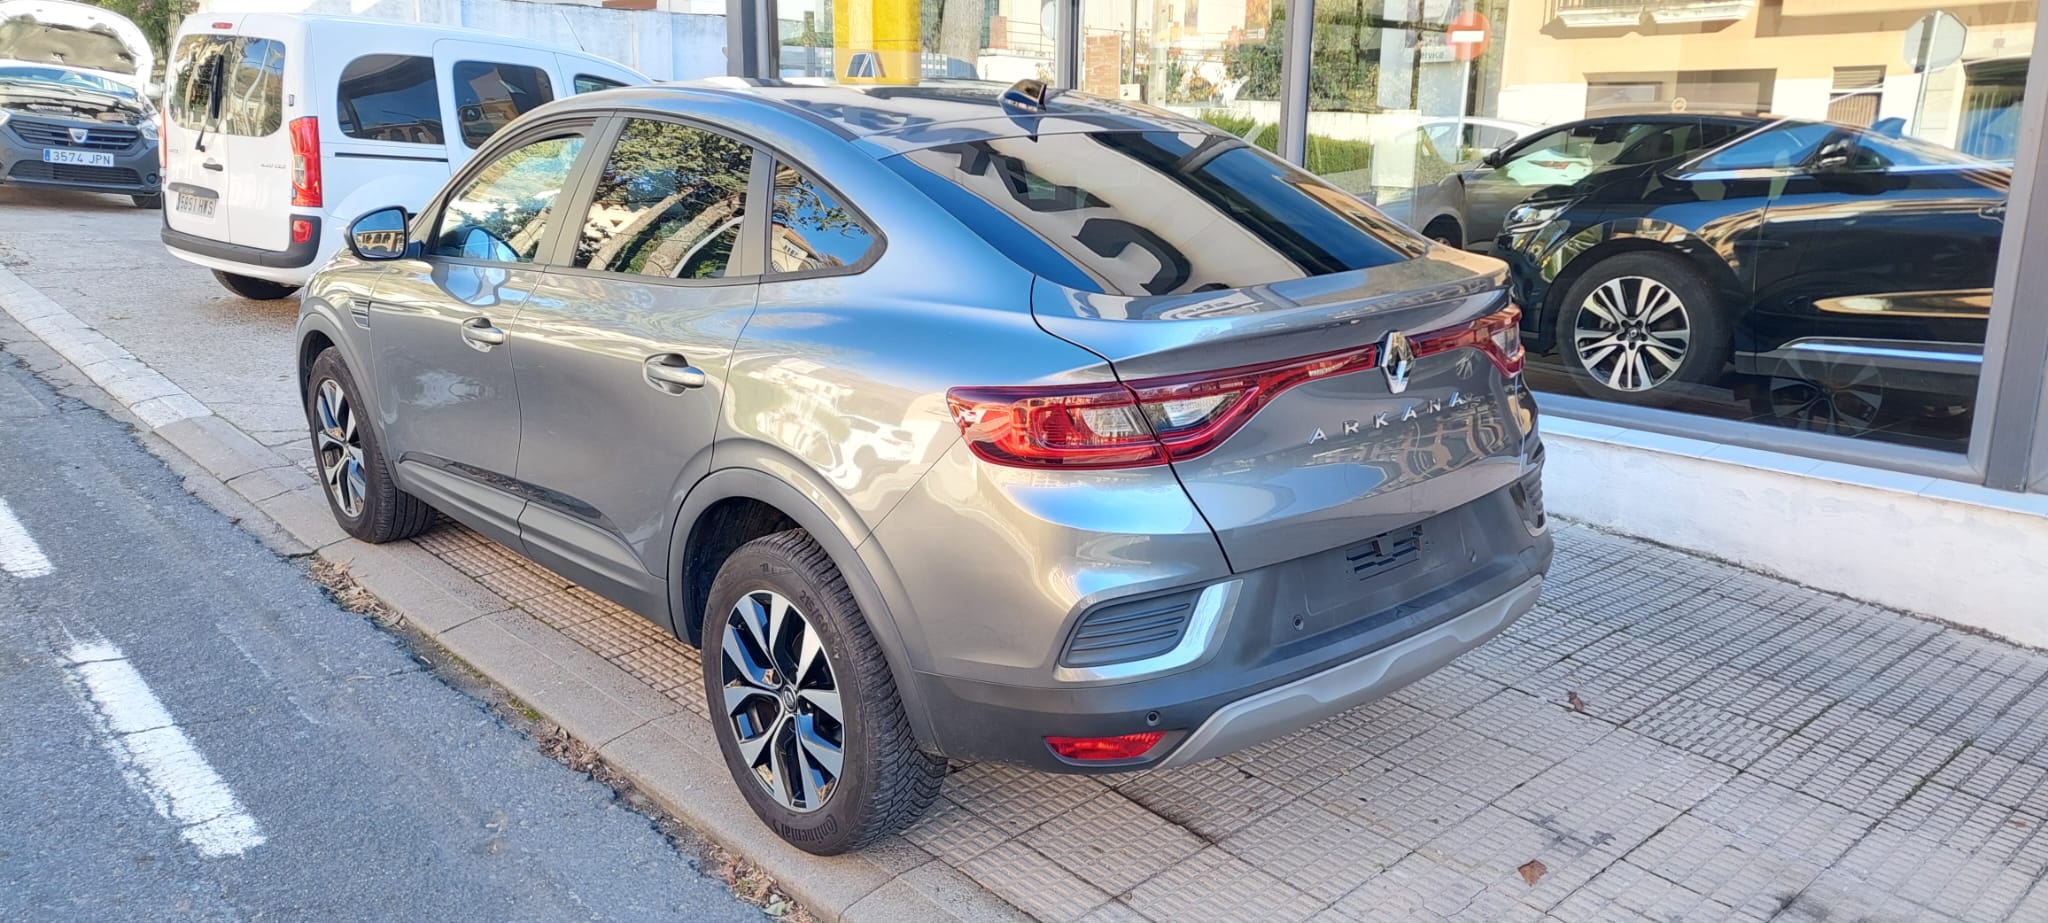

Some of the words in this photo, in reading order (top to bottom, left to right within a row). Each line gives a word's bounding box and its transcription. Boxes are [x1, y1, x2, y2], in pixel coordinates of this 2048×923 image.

[52, 151, 83, 163] 3574
[88, 154, 111, 165] JPN
[1308, 391, 1465, 445] ARKANA
